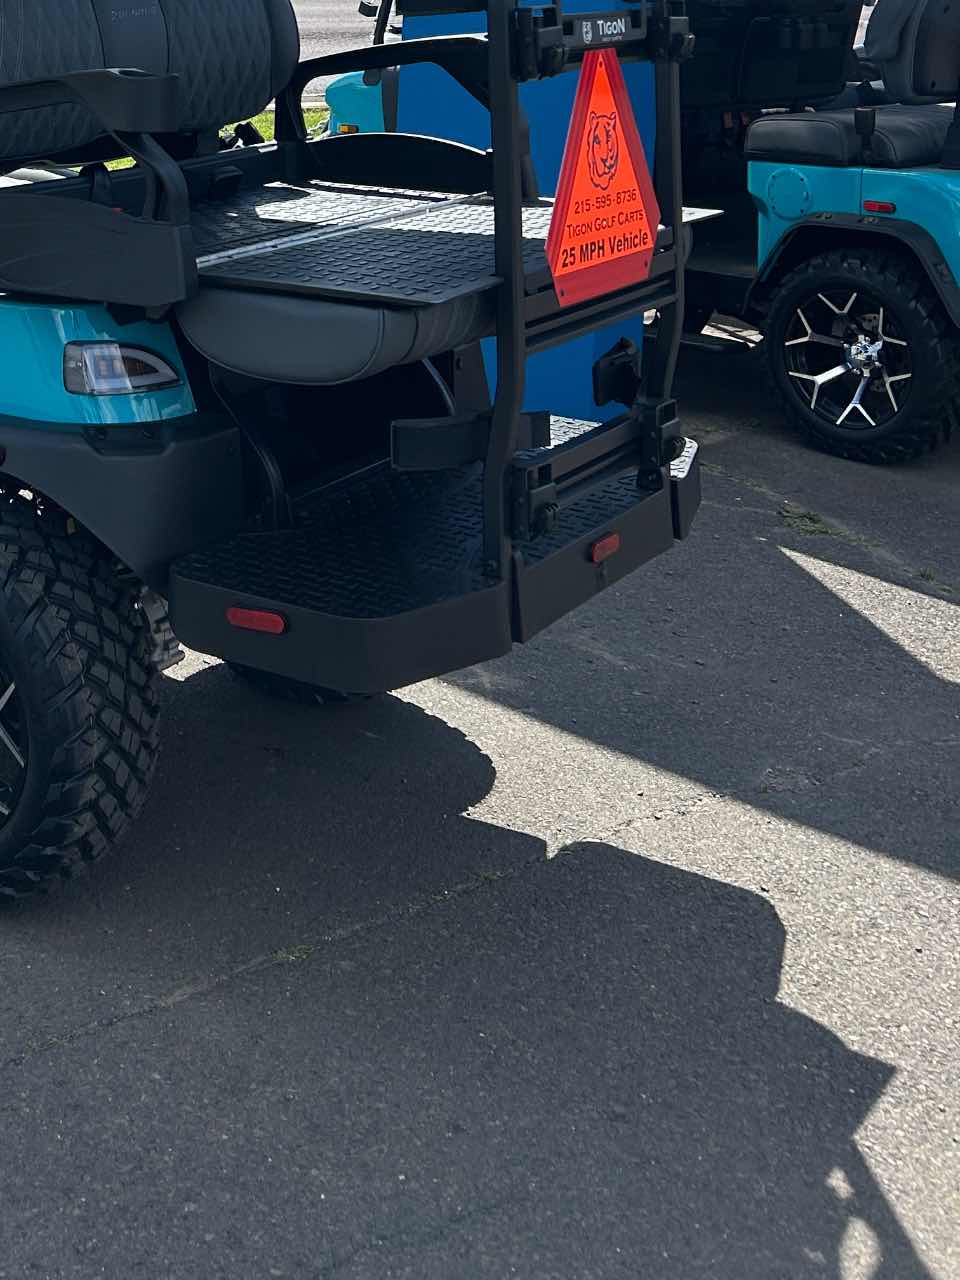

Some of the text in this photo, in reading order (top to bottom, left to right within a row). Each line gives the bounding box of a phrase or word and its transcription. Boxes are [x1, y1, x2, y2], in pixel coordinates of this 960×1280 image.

[597, 18, 625, 35] TIGON
[574, 188, 637, 214] 215-595-8736
[566, 209, 644, 239] TIGON GOLF CARTS
[561, 228, 649, 269] 25 MPH Vehicle
